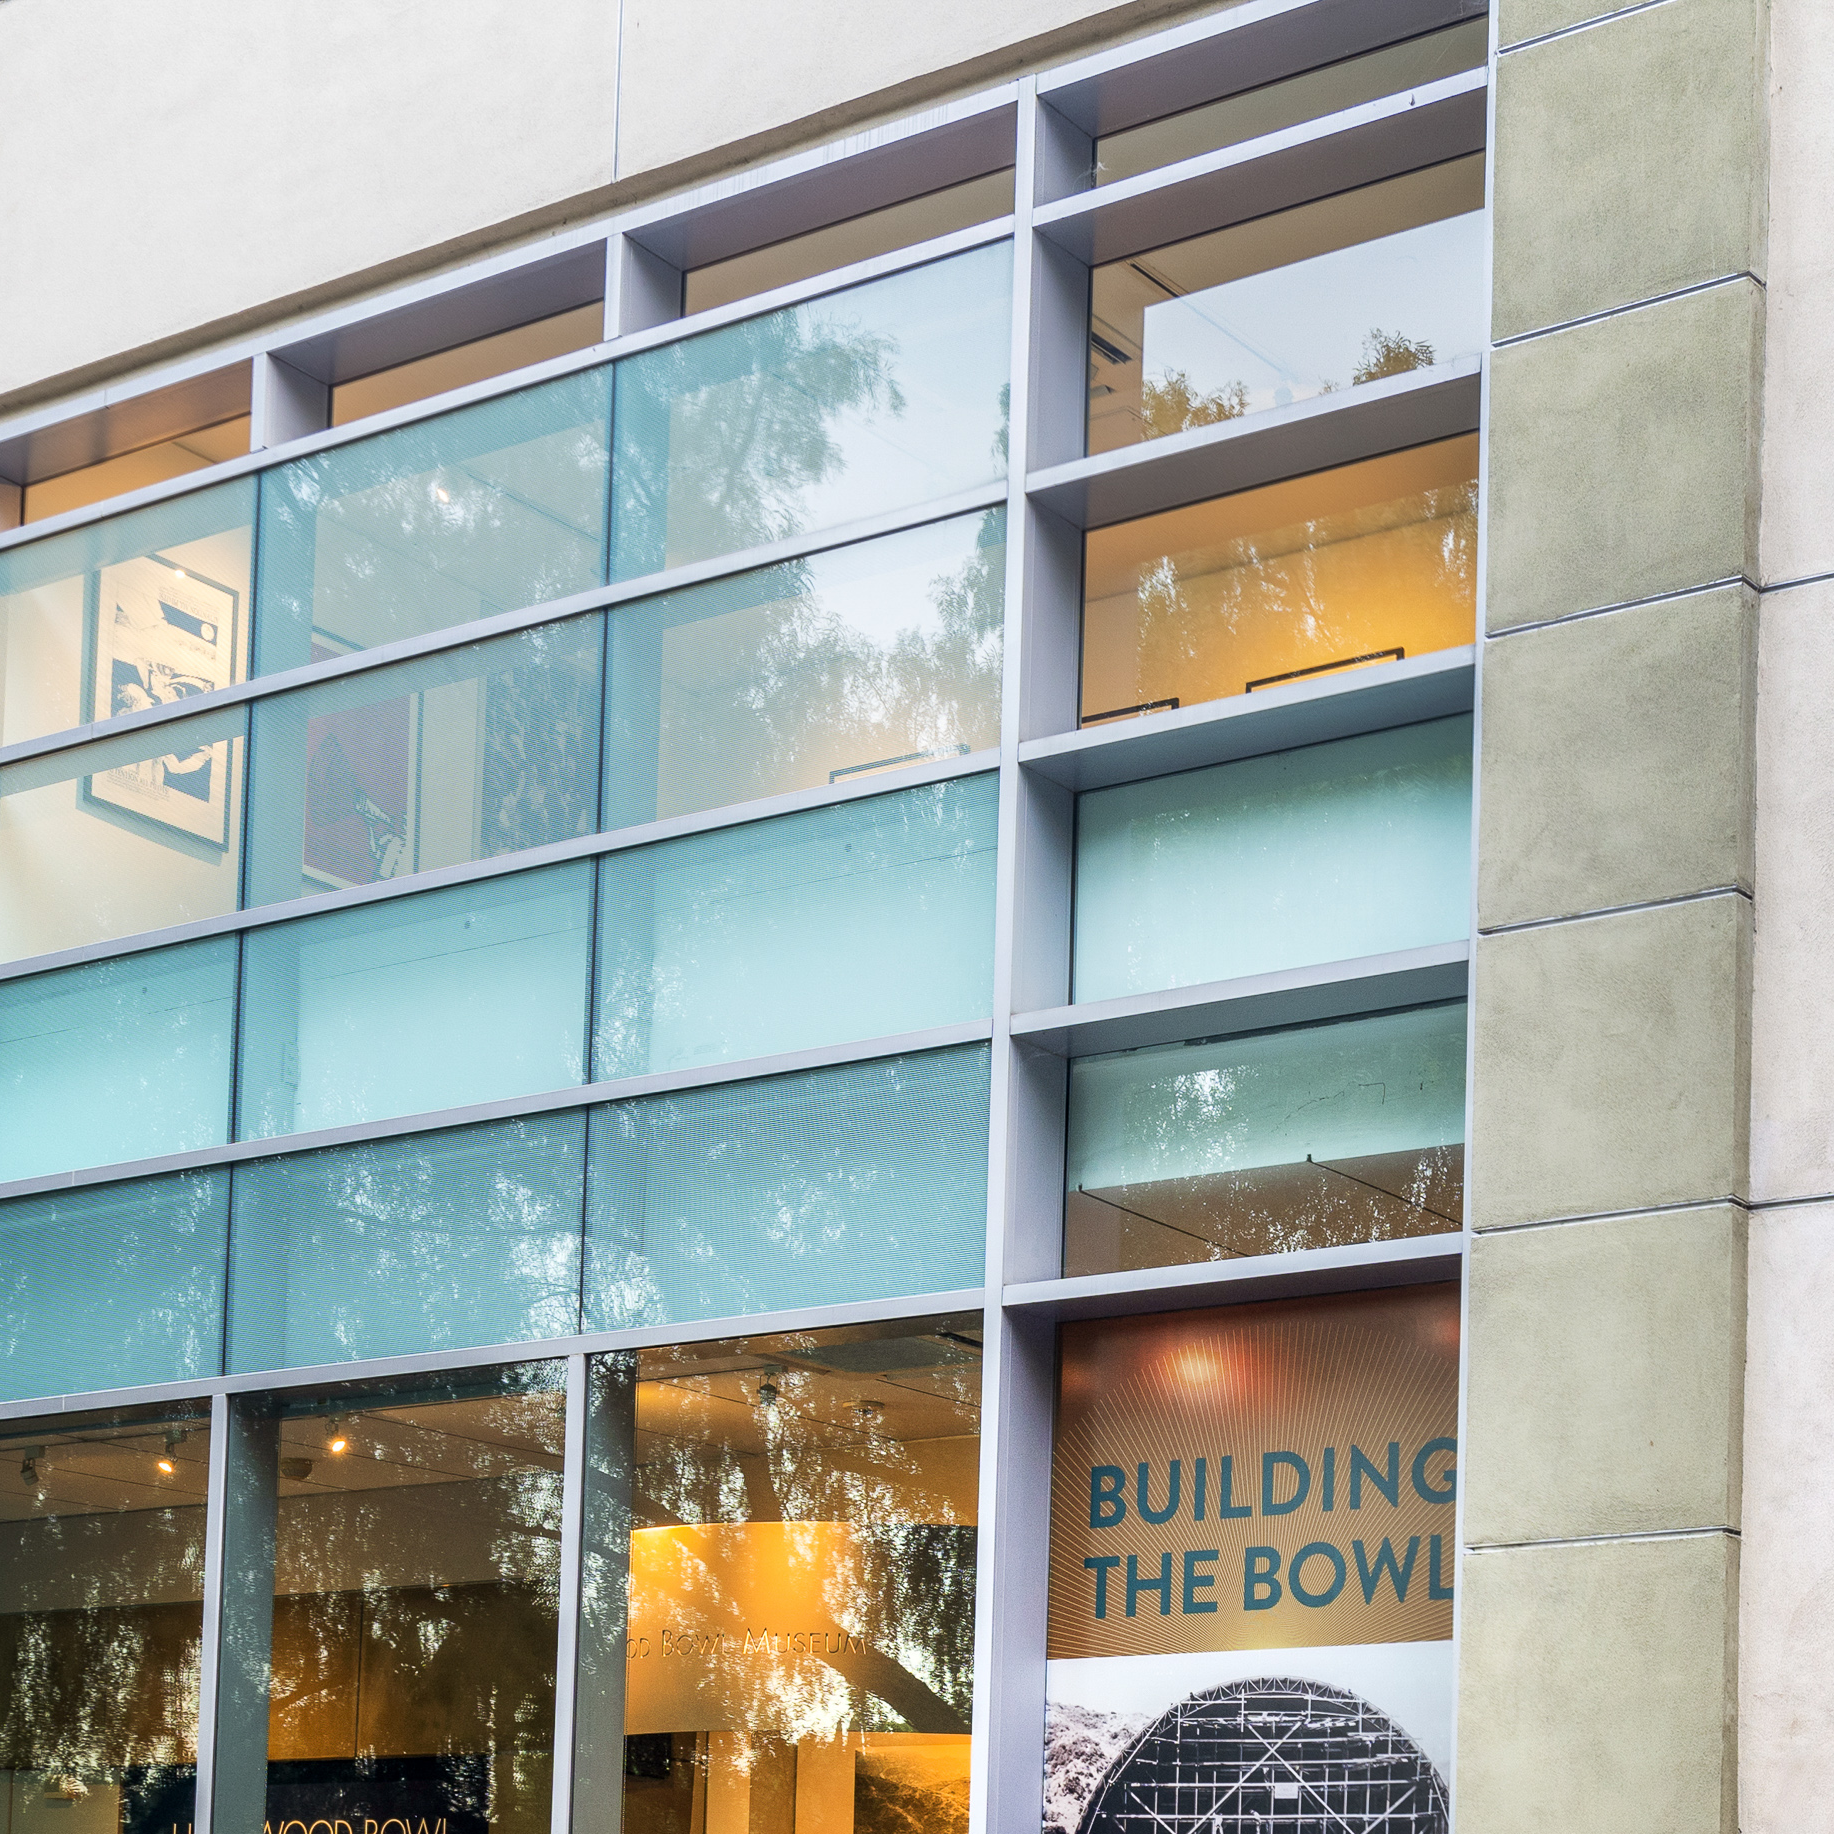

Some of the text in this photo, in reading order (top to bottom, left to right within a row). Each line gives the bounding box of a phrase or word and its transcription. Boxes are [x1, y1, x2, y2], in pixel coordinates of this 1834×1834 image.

[1089, 1437, 1457, 1529] BUILDING
[1084, 1534, 1454, 1619] THE BOWL
[662, 1629, 730, 1657] BOWL
[742, 1628, 866, 1655] MUSEUM
